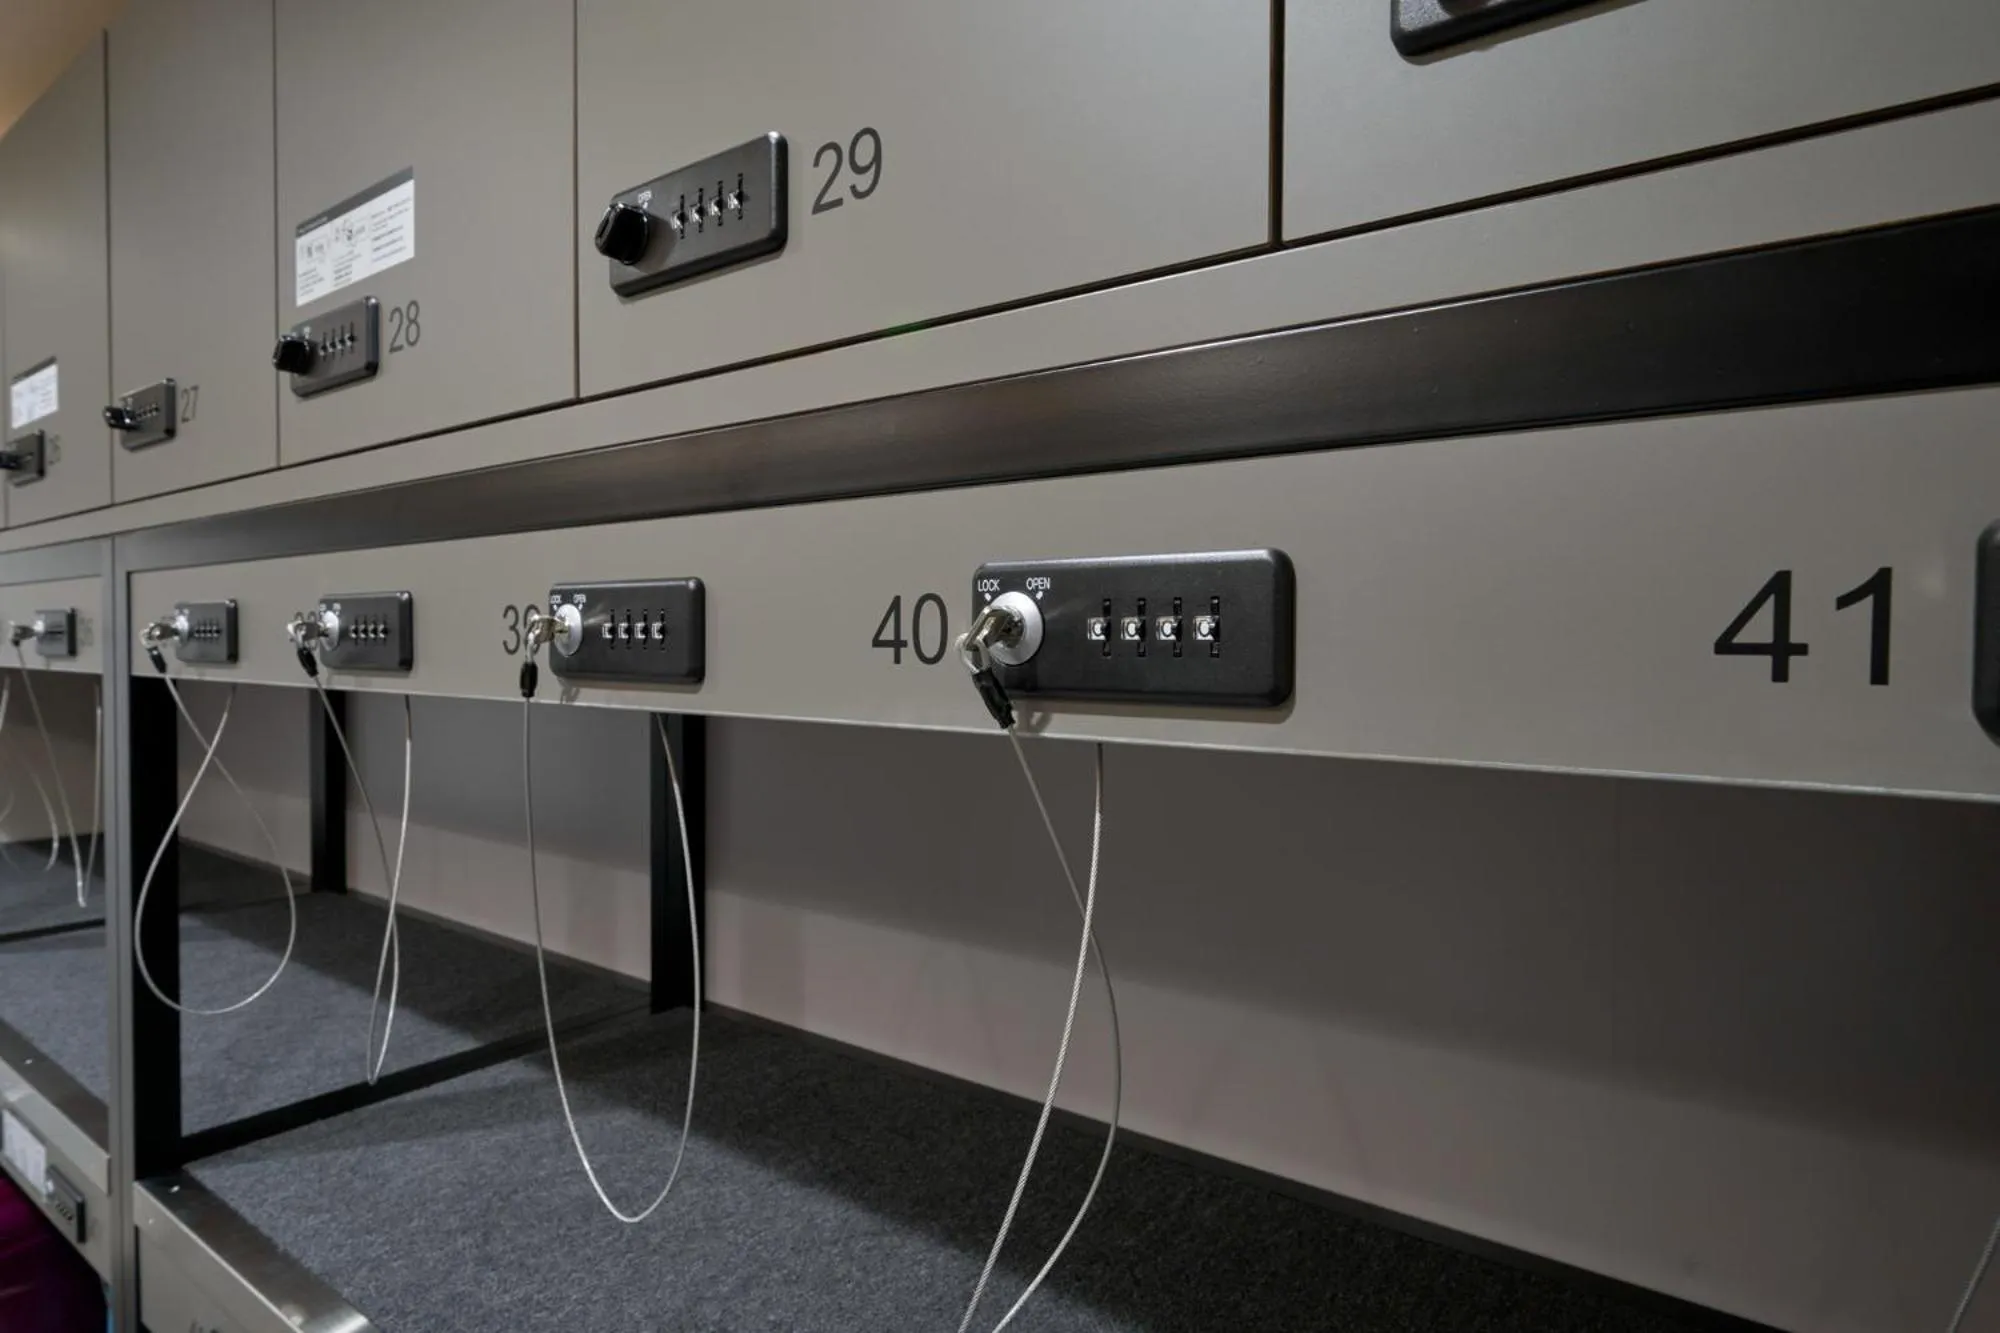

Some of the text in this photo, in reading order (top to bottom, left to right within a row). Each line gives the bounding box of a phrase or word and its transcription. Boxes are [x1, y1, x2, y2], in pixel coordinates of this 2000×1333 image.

[812, 127, 882, 215] 29
[388, 300, 421, 354] 28
[180, 385, 201, 422] 27
[977, 577, 1051, 592] LOCK OPEN
[871, 592, 949, 665] 40
[1713, 566, 1892, 686] 41
